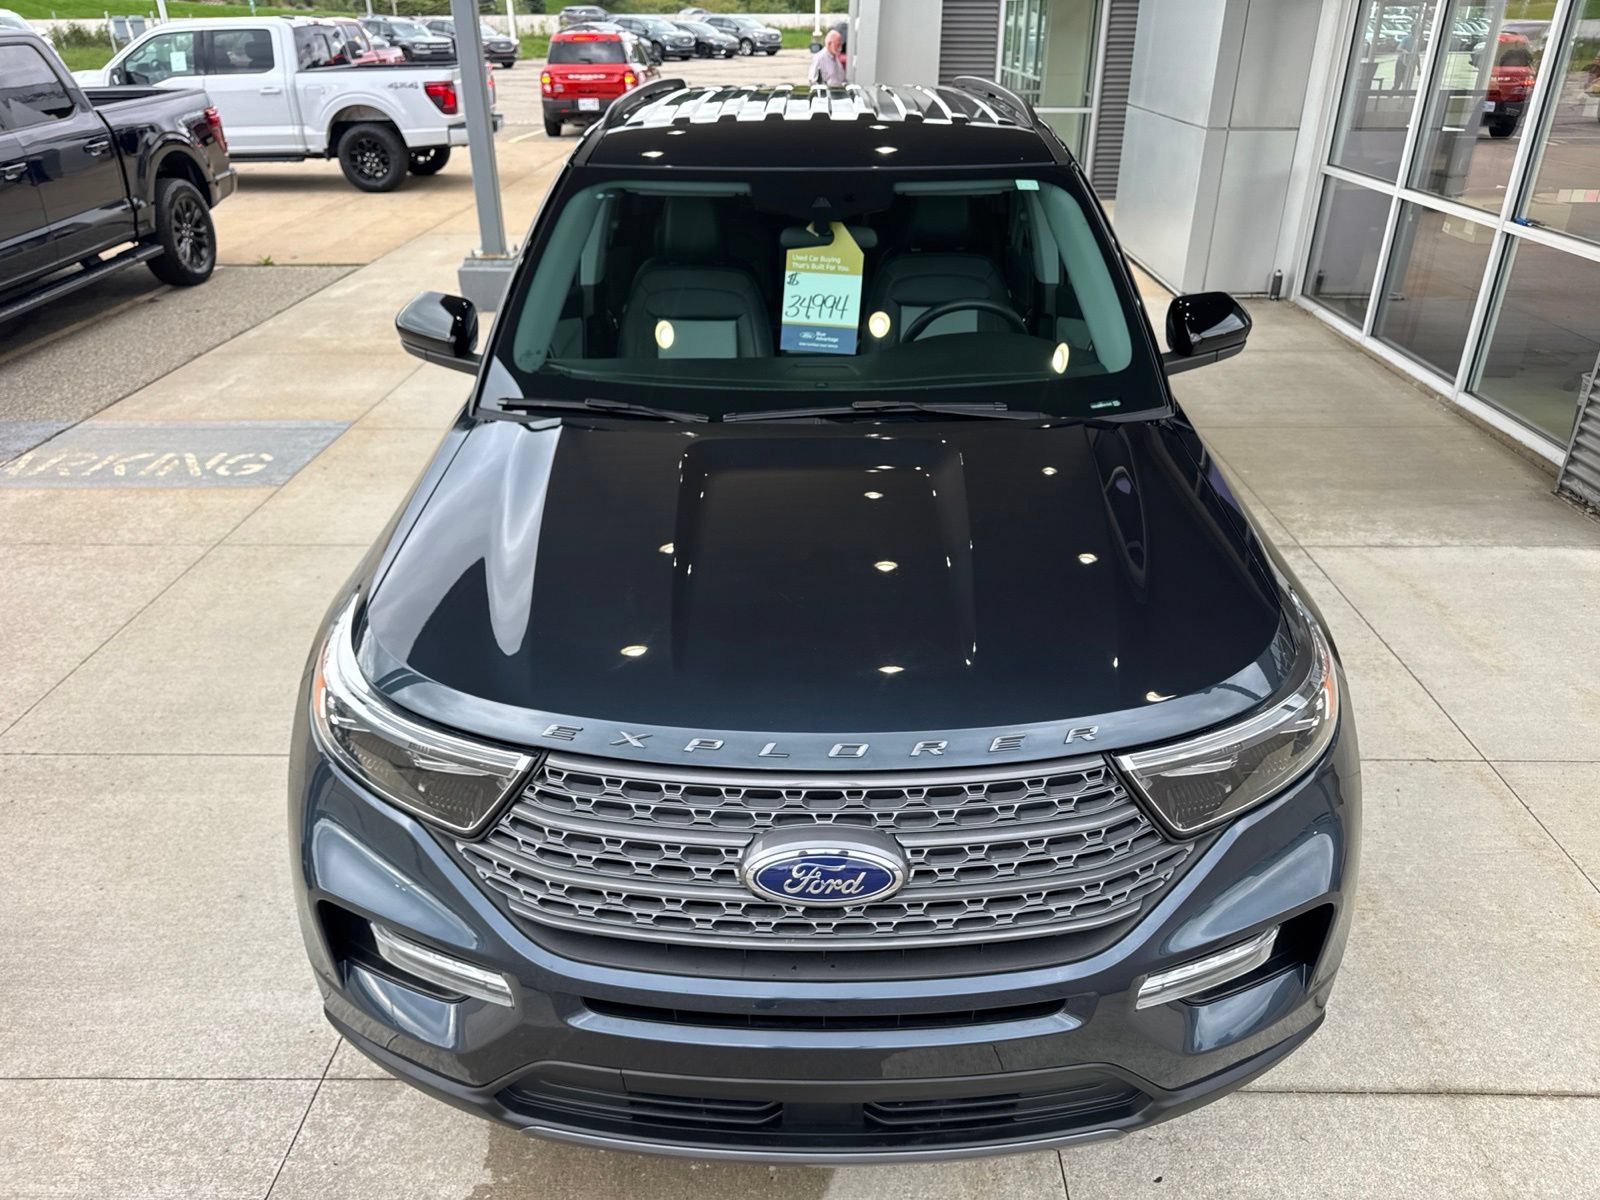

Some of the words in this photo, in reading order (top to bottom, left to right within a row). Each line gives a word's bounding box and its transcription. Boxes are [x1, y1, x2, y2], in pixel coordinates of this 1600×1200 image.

[820, 256, 841, 264] Buying
[785, 293, 849, 320] 34994
[541, 724, 1099, 759] EXPLORER
[783, 862, 867, 895] Ford
